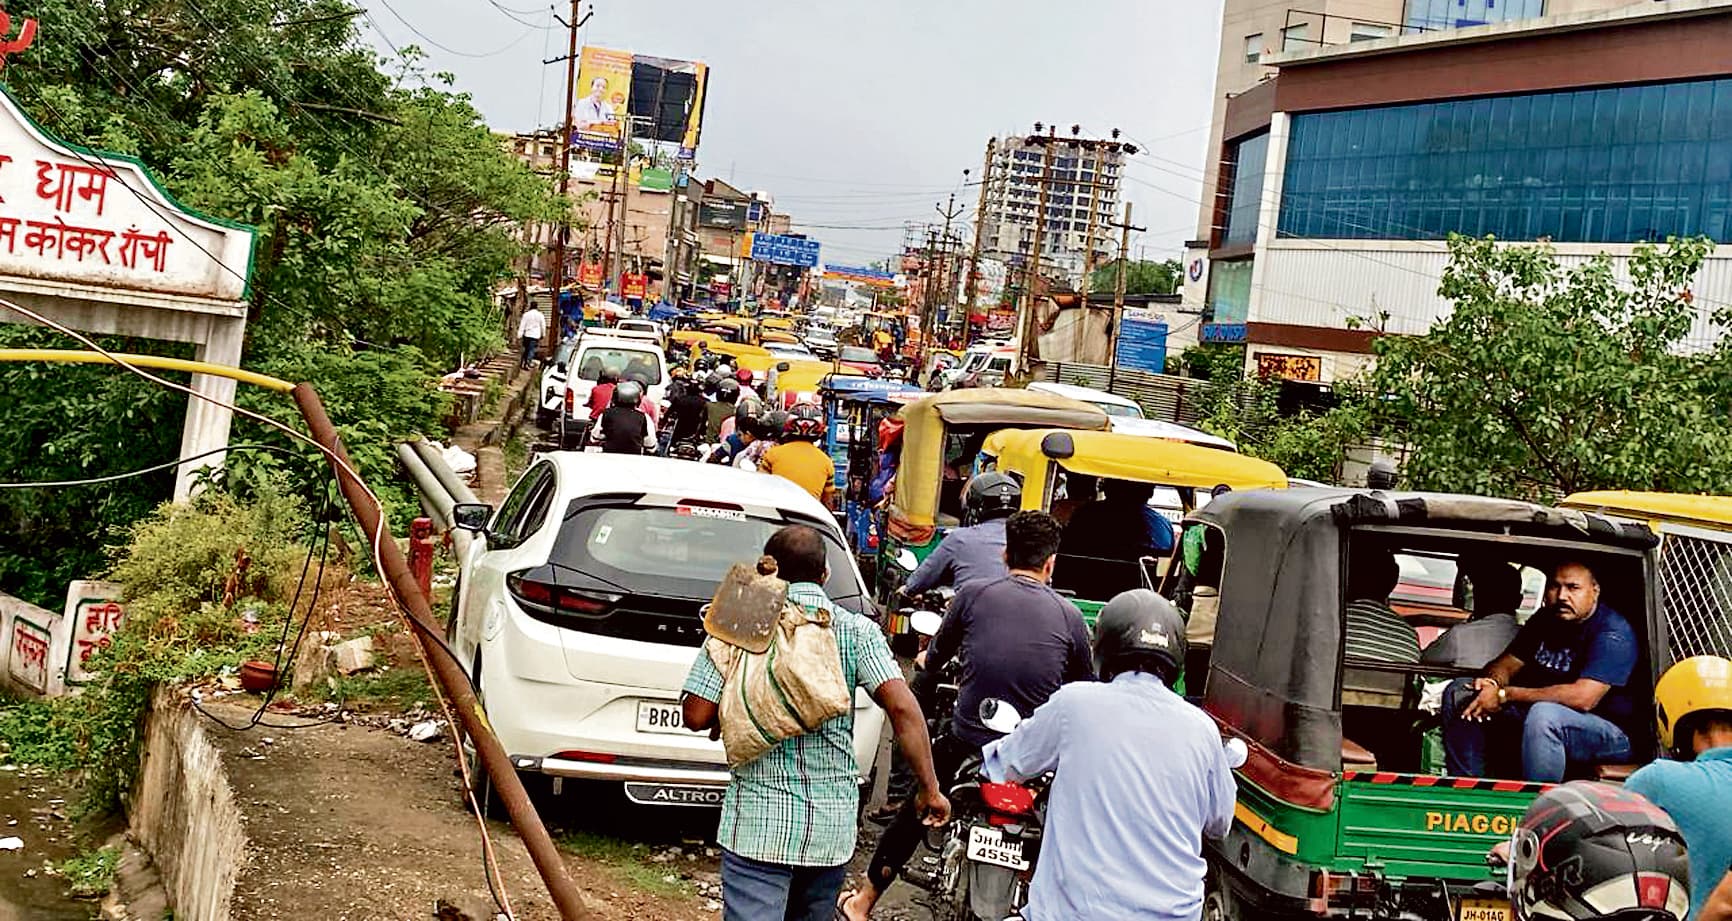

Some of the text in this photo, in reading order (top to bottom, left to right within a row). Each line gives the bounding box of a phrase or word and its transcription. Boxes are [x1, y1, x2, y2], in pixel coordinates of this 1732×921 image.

[35, 159, 119, 217] धाम
[24, 215, 117, 265] कोकर
[119, 224, 174, 273] राँची
[648, 707, 687, 729] BR0
[975, 847, 1021, 866] 4555
